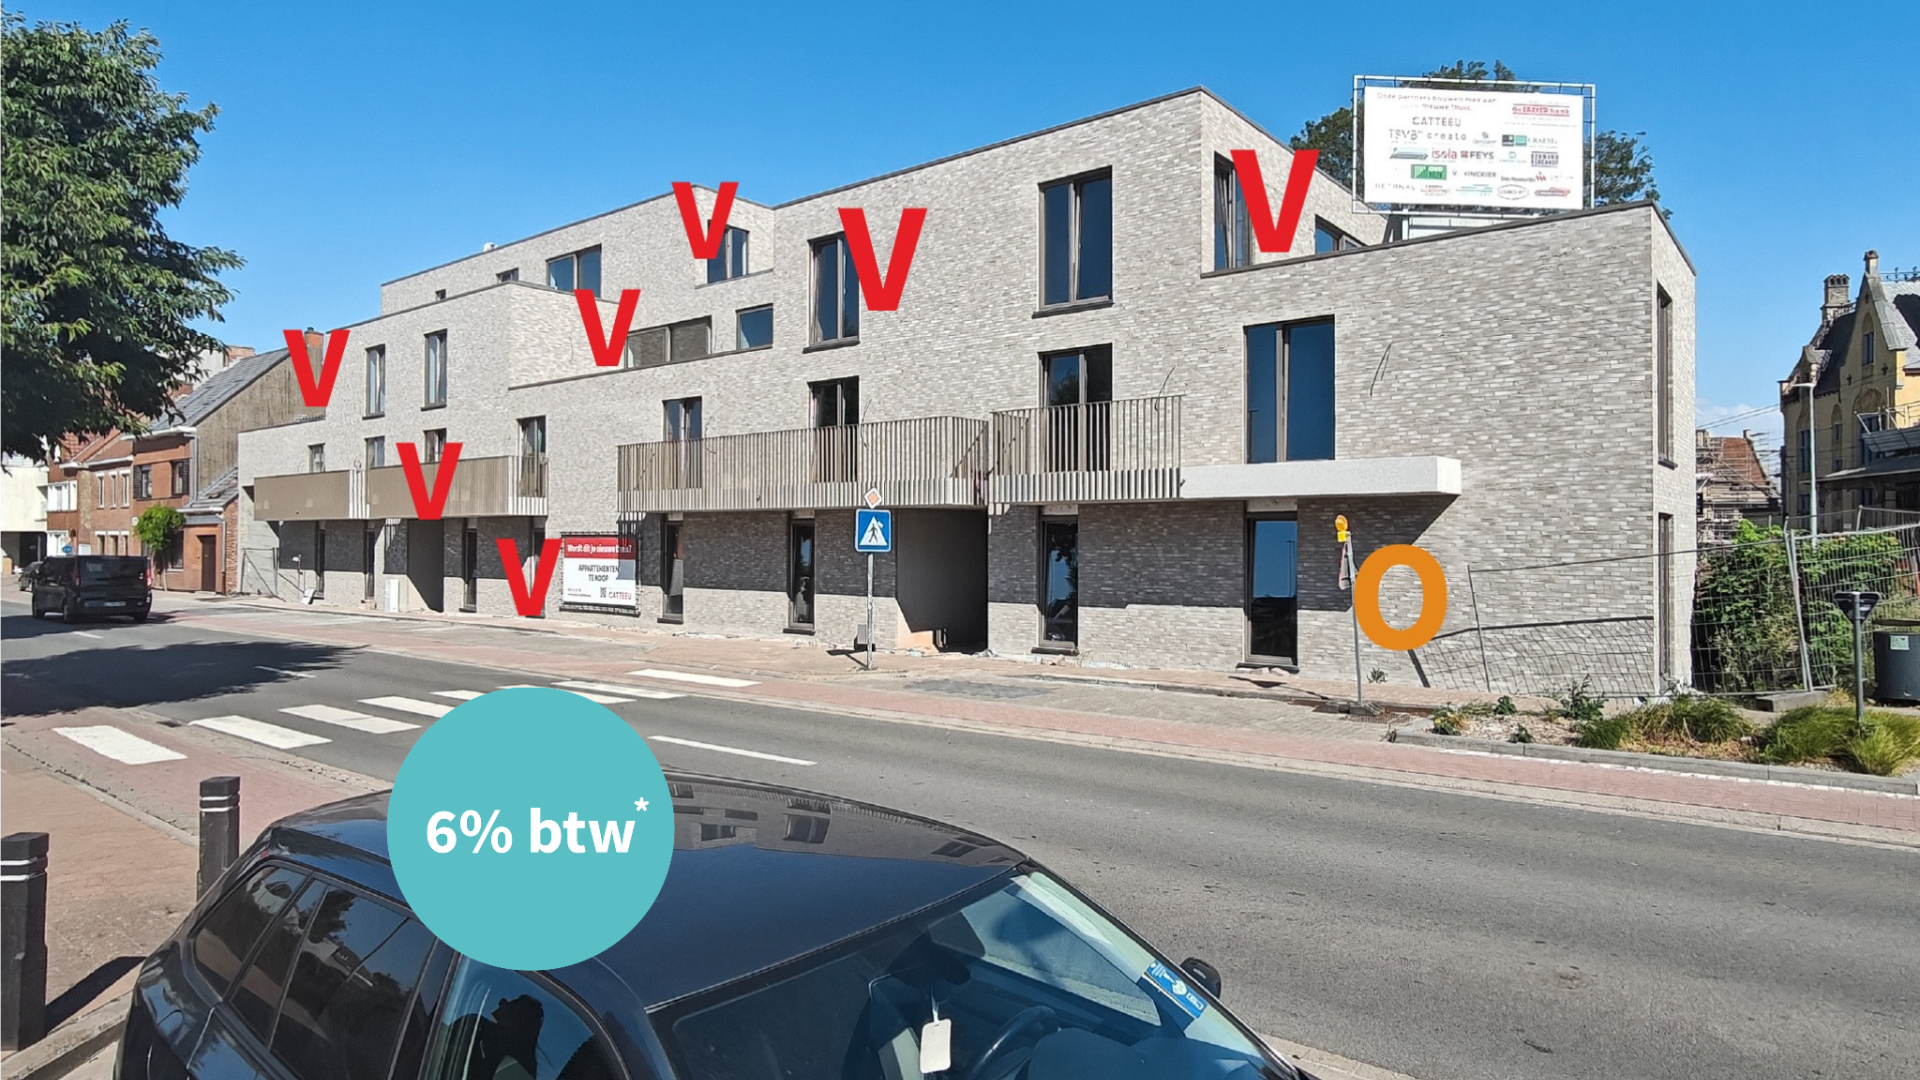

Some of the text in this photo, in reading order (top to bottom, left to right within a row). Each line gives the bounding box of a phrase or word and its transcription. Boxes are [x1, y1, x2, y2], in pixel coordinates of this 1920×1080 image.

[1412, 116, 1462, 127] CATTEEU
[1470, 151, 1495, 160] FEYS
[578, 564, 619, 573] APPARTEMENTEN
[595, 574, 609, 582] KOOP
[608, 591, 632, 600] CATTEEU
